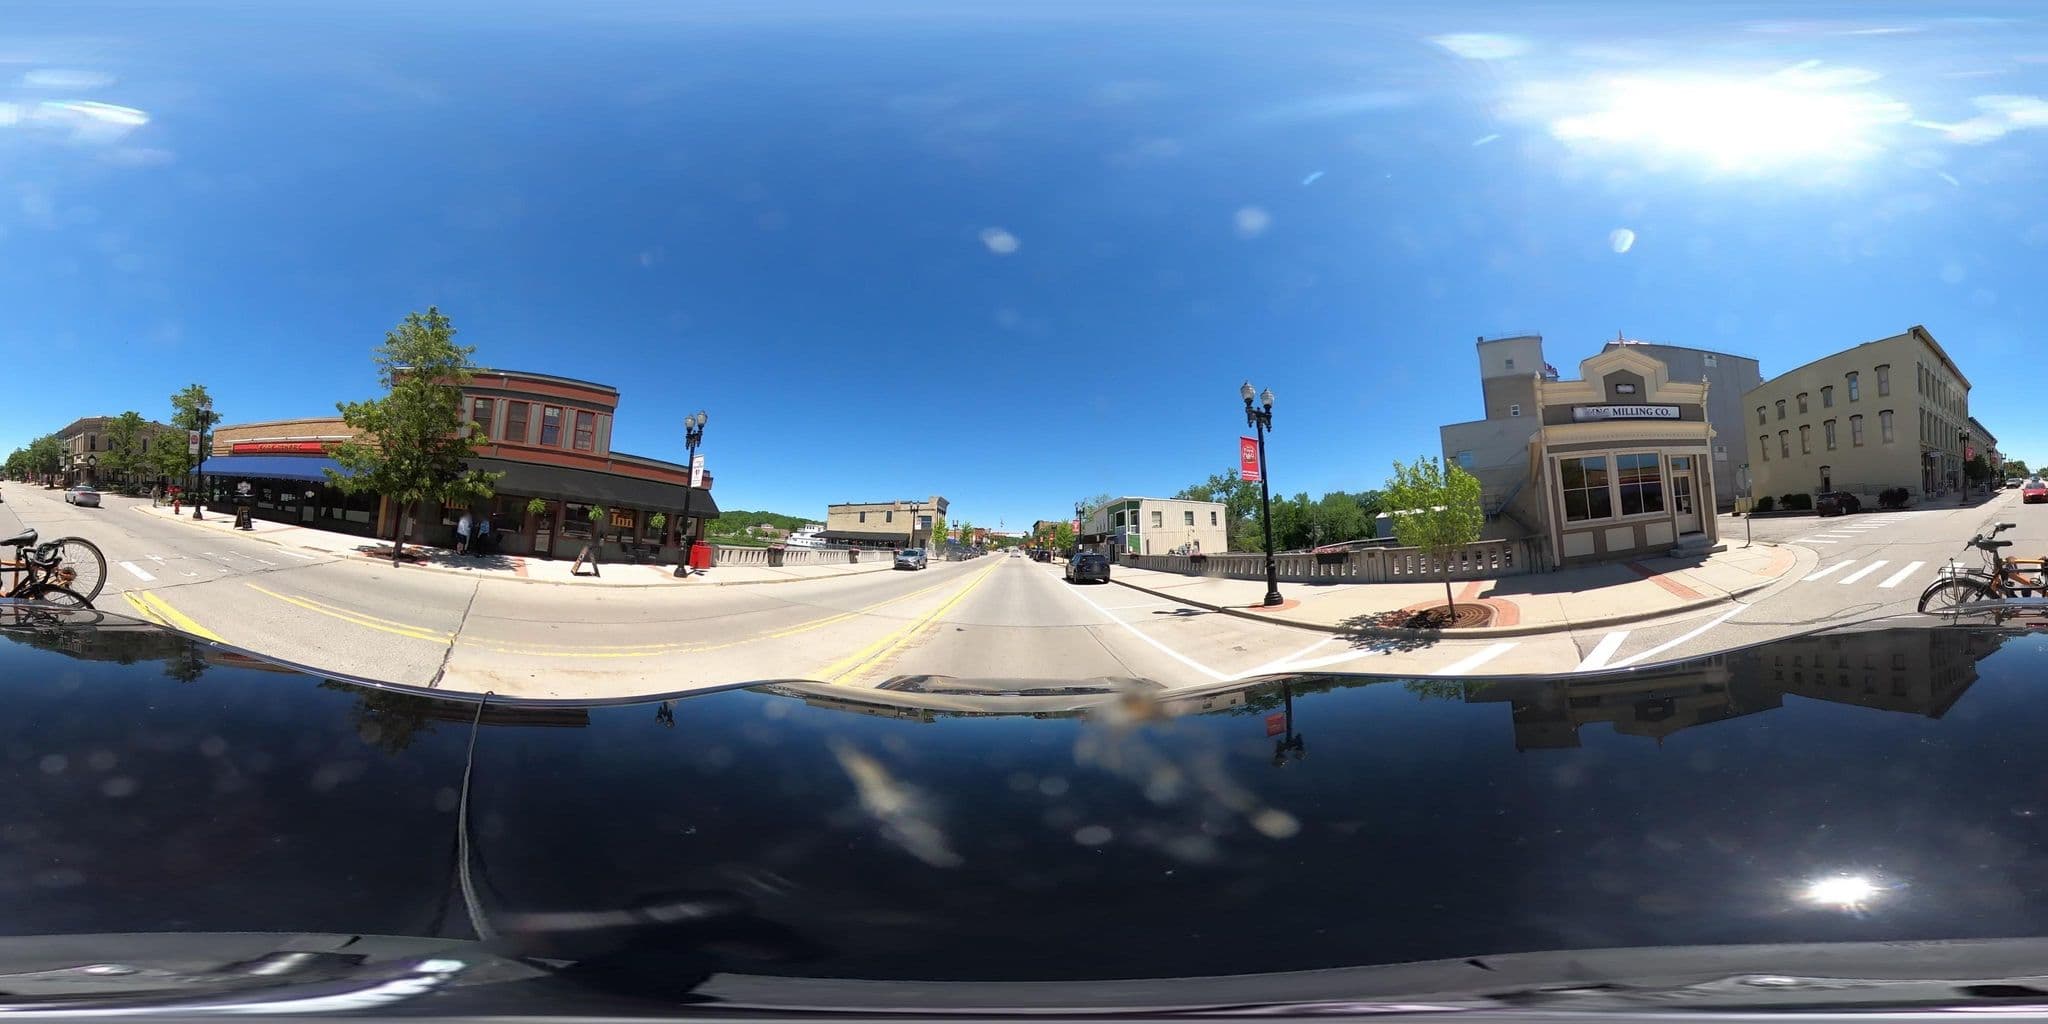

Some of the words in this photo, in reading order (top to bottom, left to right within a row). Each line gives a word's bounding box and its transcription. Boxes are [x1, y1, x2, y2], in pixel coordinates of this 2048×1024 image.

[1612, 407, 1653, 417] MILLING
[1655, 407, 1671, 417] CO.
[611, 513, 633, 528] Inn
